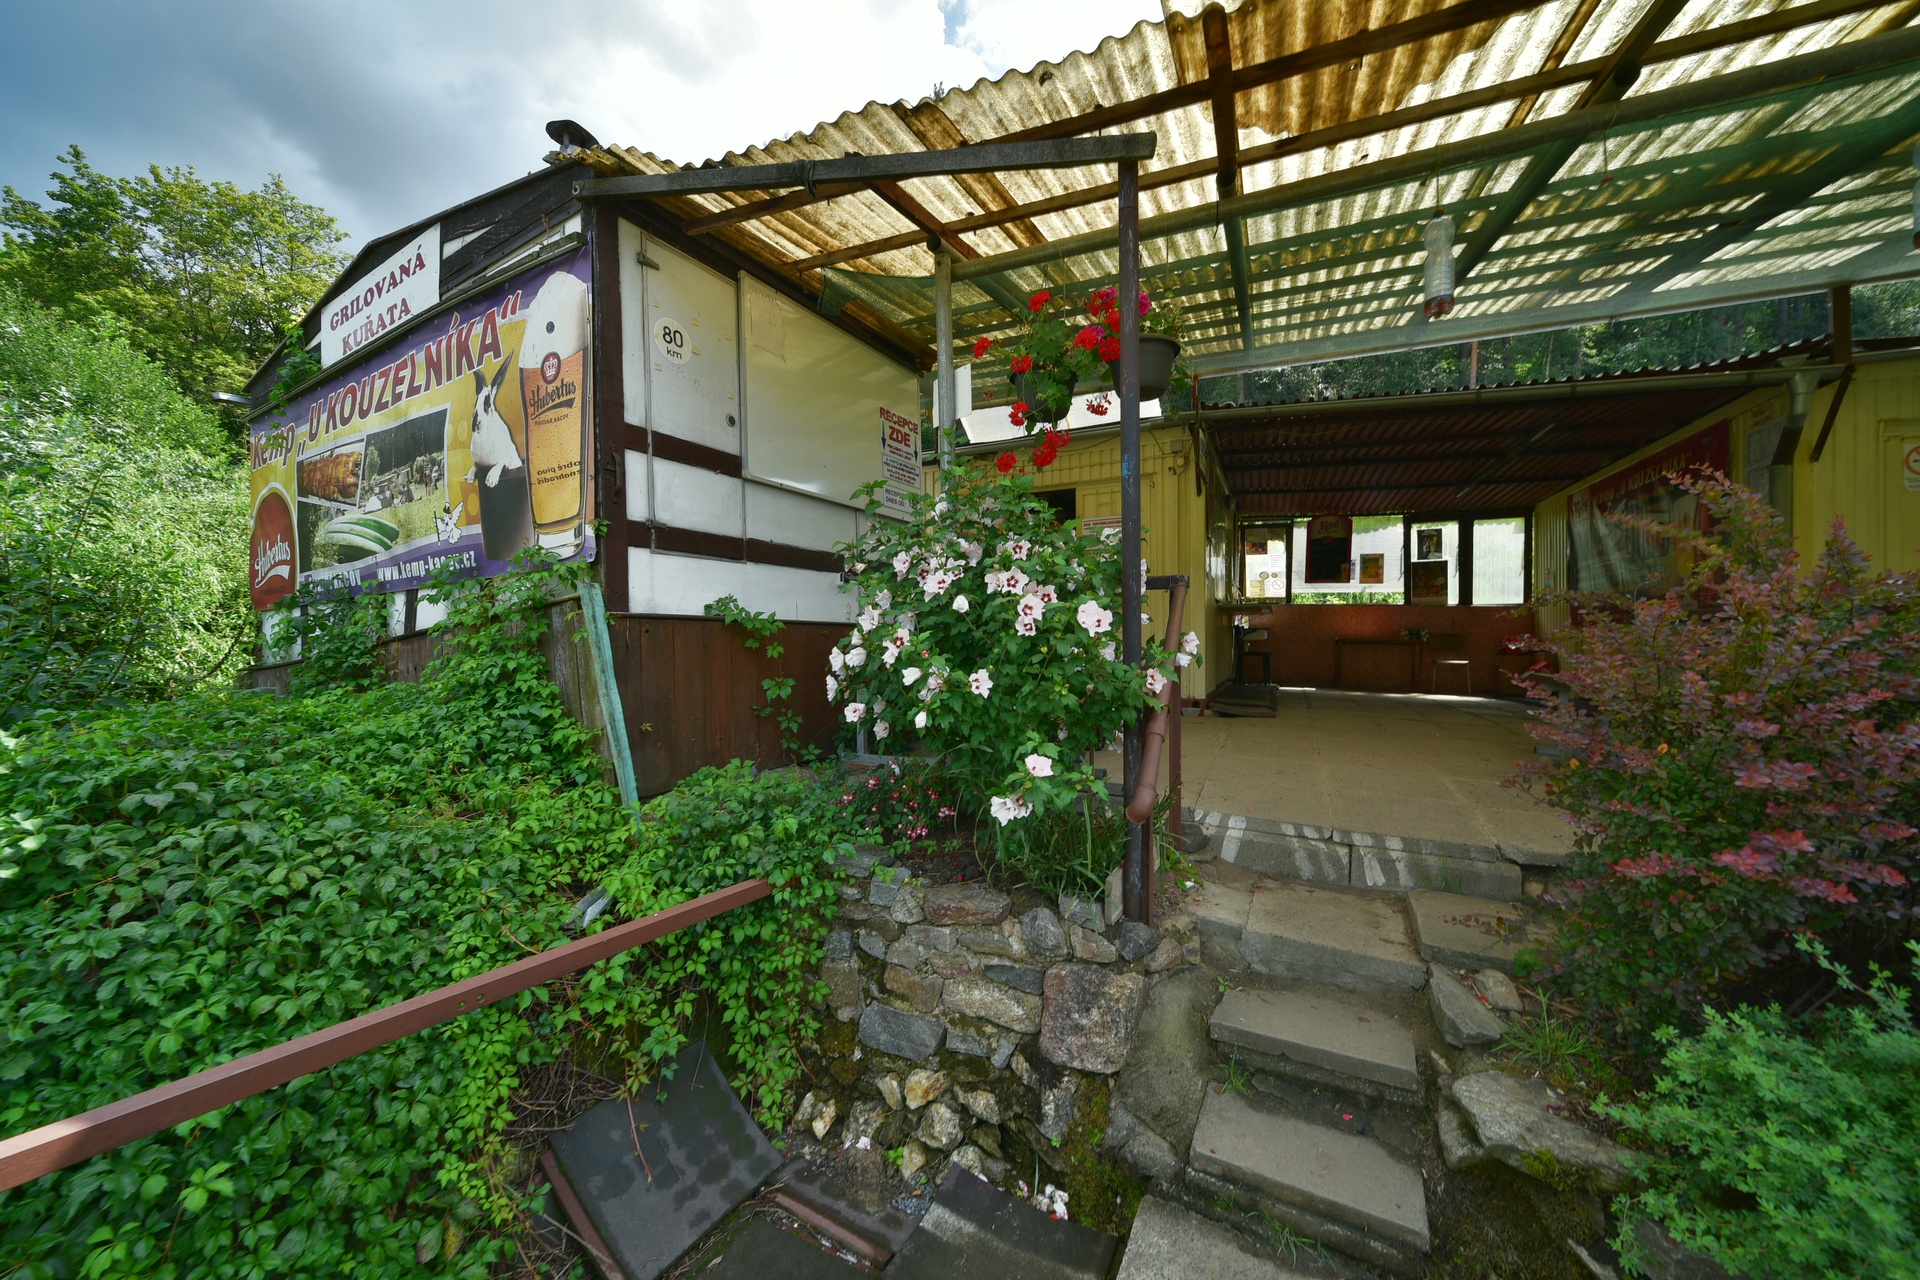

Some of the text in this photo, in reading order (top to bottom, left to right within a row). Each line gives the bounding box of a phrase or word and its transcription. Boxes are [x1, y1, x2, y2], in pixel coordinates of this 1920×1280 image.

[330, 244, 426, 331] GRILOVANÁ
[341, 297, 411, 356] KUŘATA
[662, 325, 684, 349] 80
[666, 346, 683, 360] km
[529, 377, 577, 416] Hubertus
[879, 406, 919, 435] RECEPCE
[252, 423, 296, 472] Kemp
[888, 425, 911, 448] ZDE
[884, 488, 907, 499] RECEPC
[885, 496, 898, 505] DNES
[254, 533, 291, 581] Hubertus
